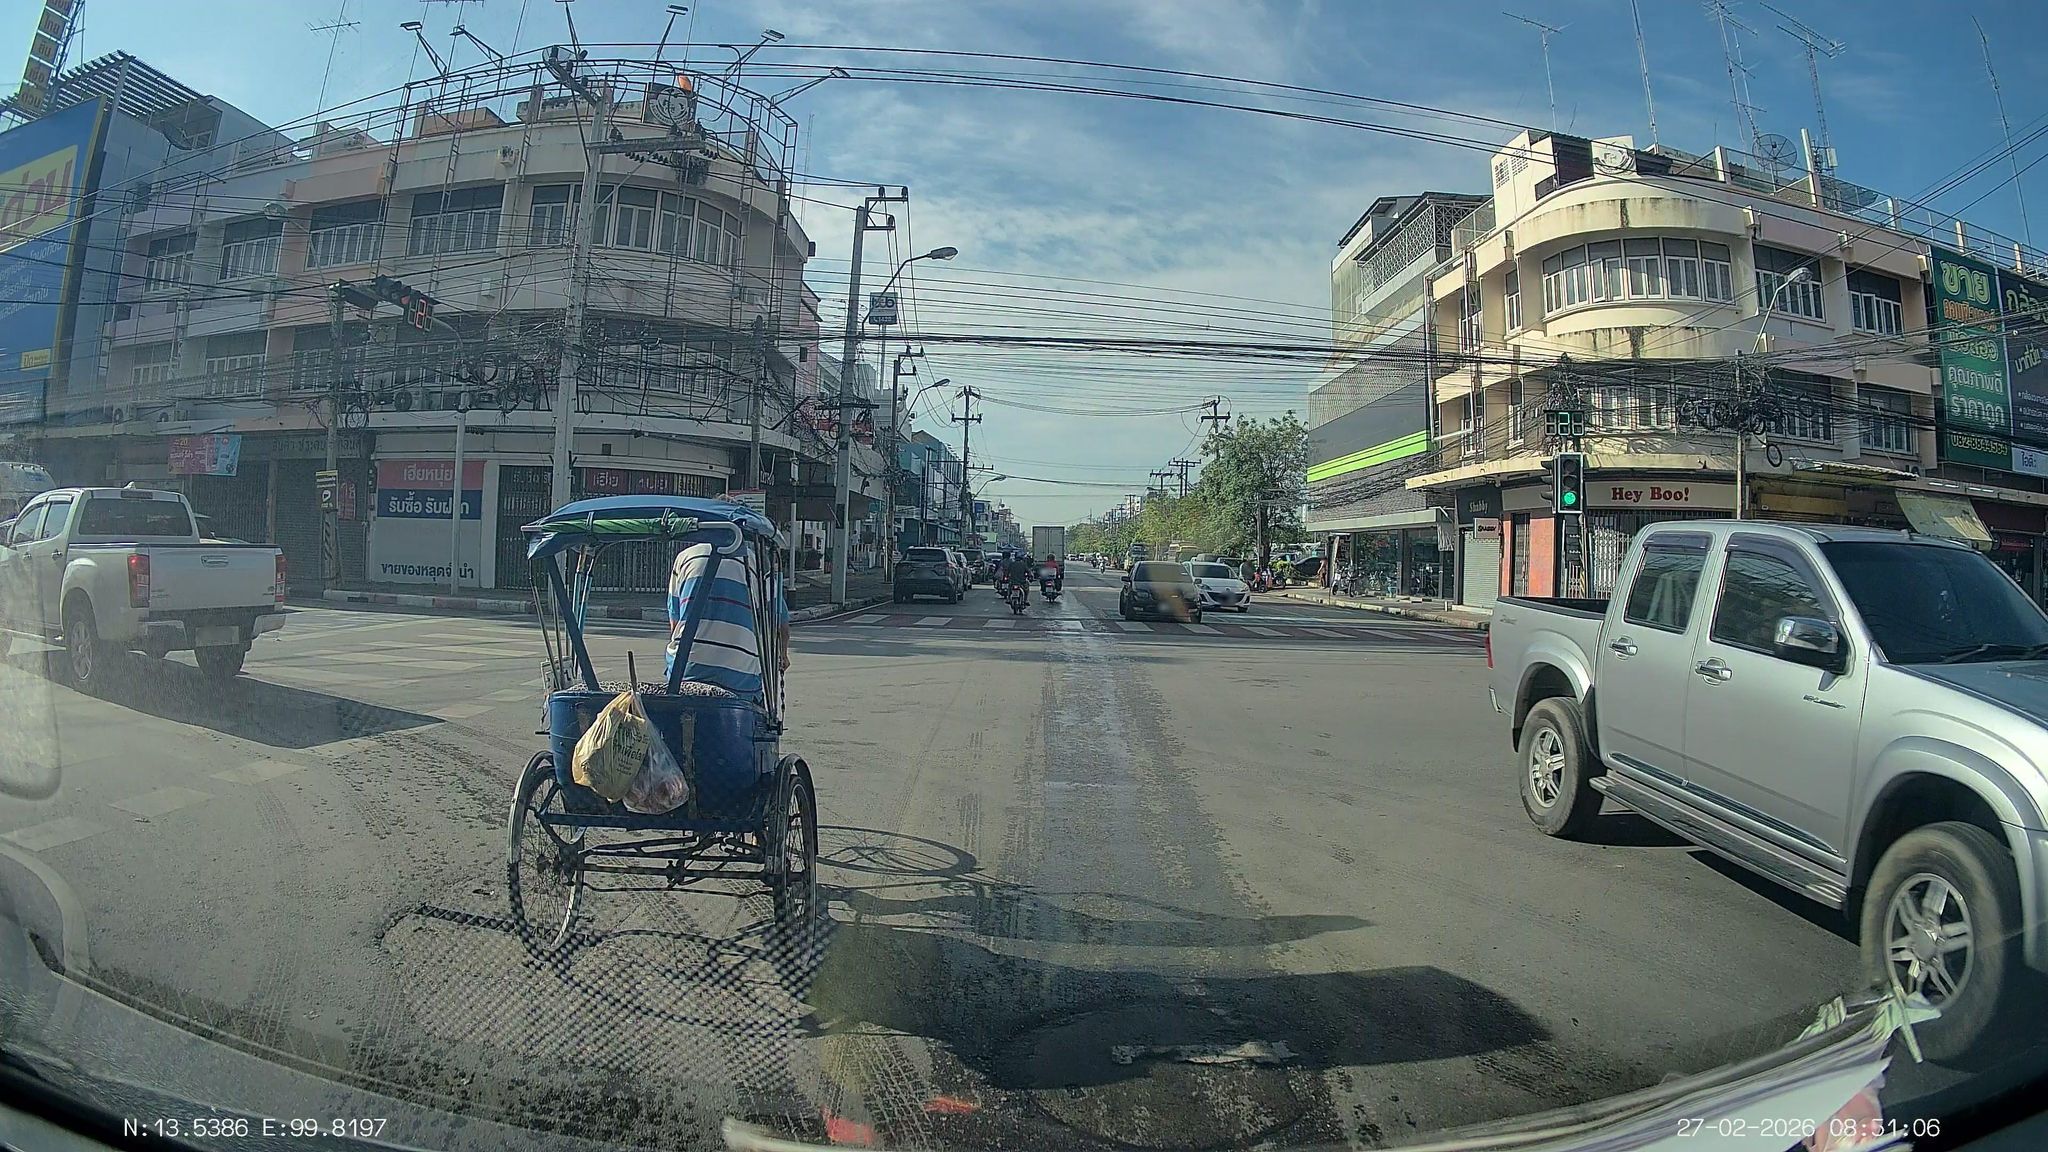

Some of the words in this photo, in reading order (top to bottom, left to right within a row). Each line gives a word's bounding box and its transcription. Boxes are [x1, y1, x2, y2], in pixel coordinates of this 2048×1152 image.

[1940, 261, 1991, 305] ขาย
[1948, 365, 2004, 395] คุณภาพดี
[1951, 394, 2006, 429] ราคาถูก
[403, 463, 454, 487] เฮียหนุ่ย
[388, 491, 422, 514] รับซื้อ
[425, 497, 470, 515] รับฝก
[1611, 487, 1642, 503] Hey
[1650, 486, 1690, 501] Boo!
[381, 562, 474, 582] ขายของหลุดจนำ
